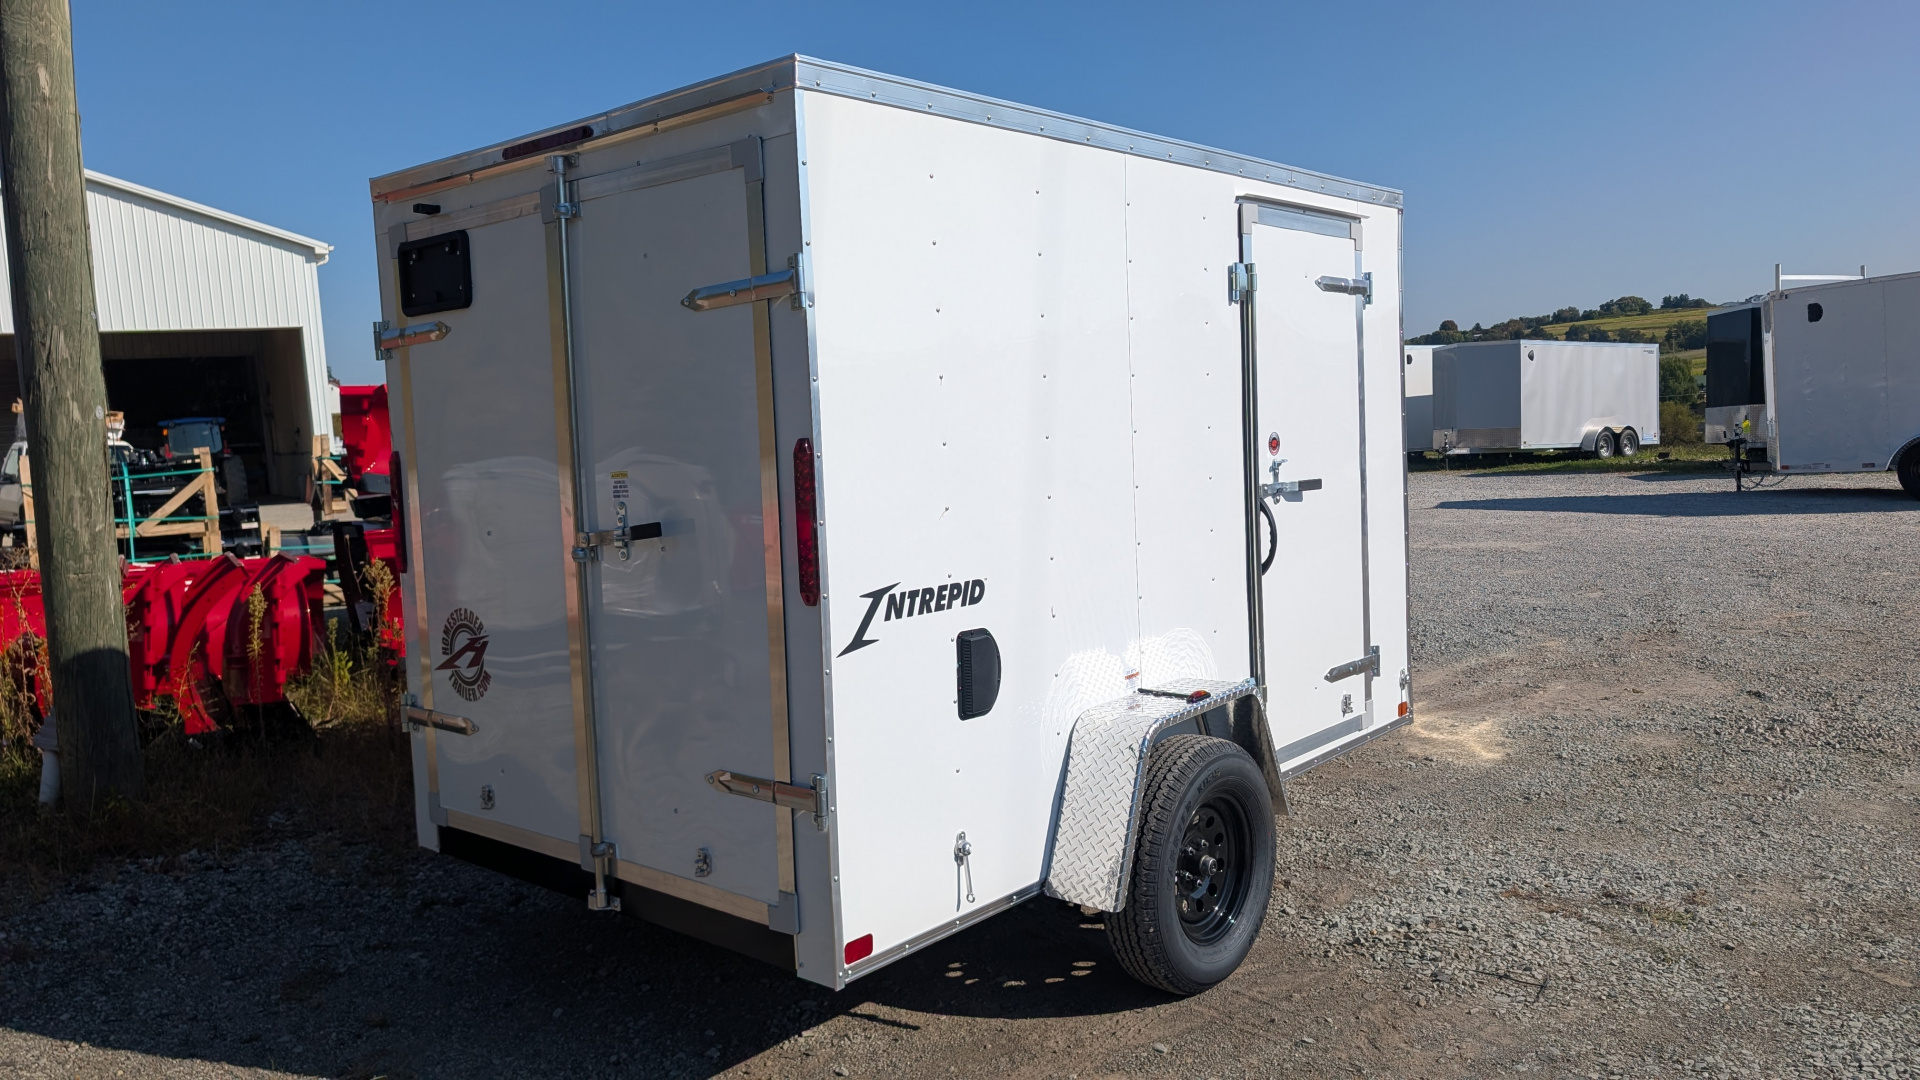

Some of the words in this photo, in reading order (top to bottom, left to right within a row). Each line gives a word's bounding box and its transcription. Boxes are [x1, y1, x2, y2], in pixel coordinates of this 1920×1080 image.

[441, 607, 484, 656] HOMESTEADER
[836, 579, 986, 658] INTREPID
[448, 669, 492, 702] TRAILER.COM
